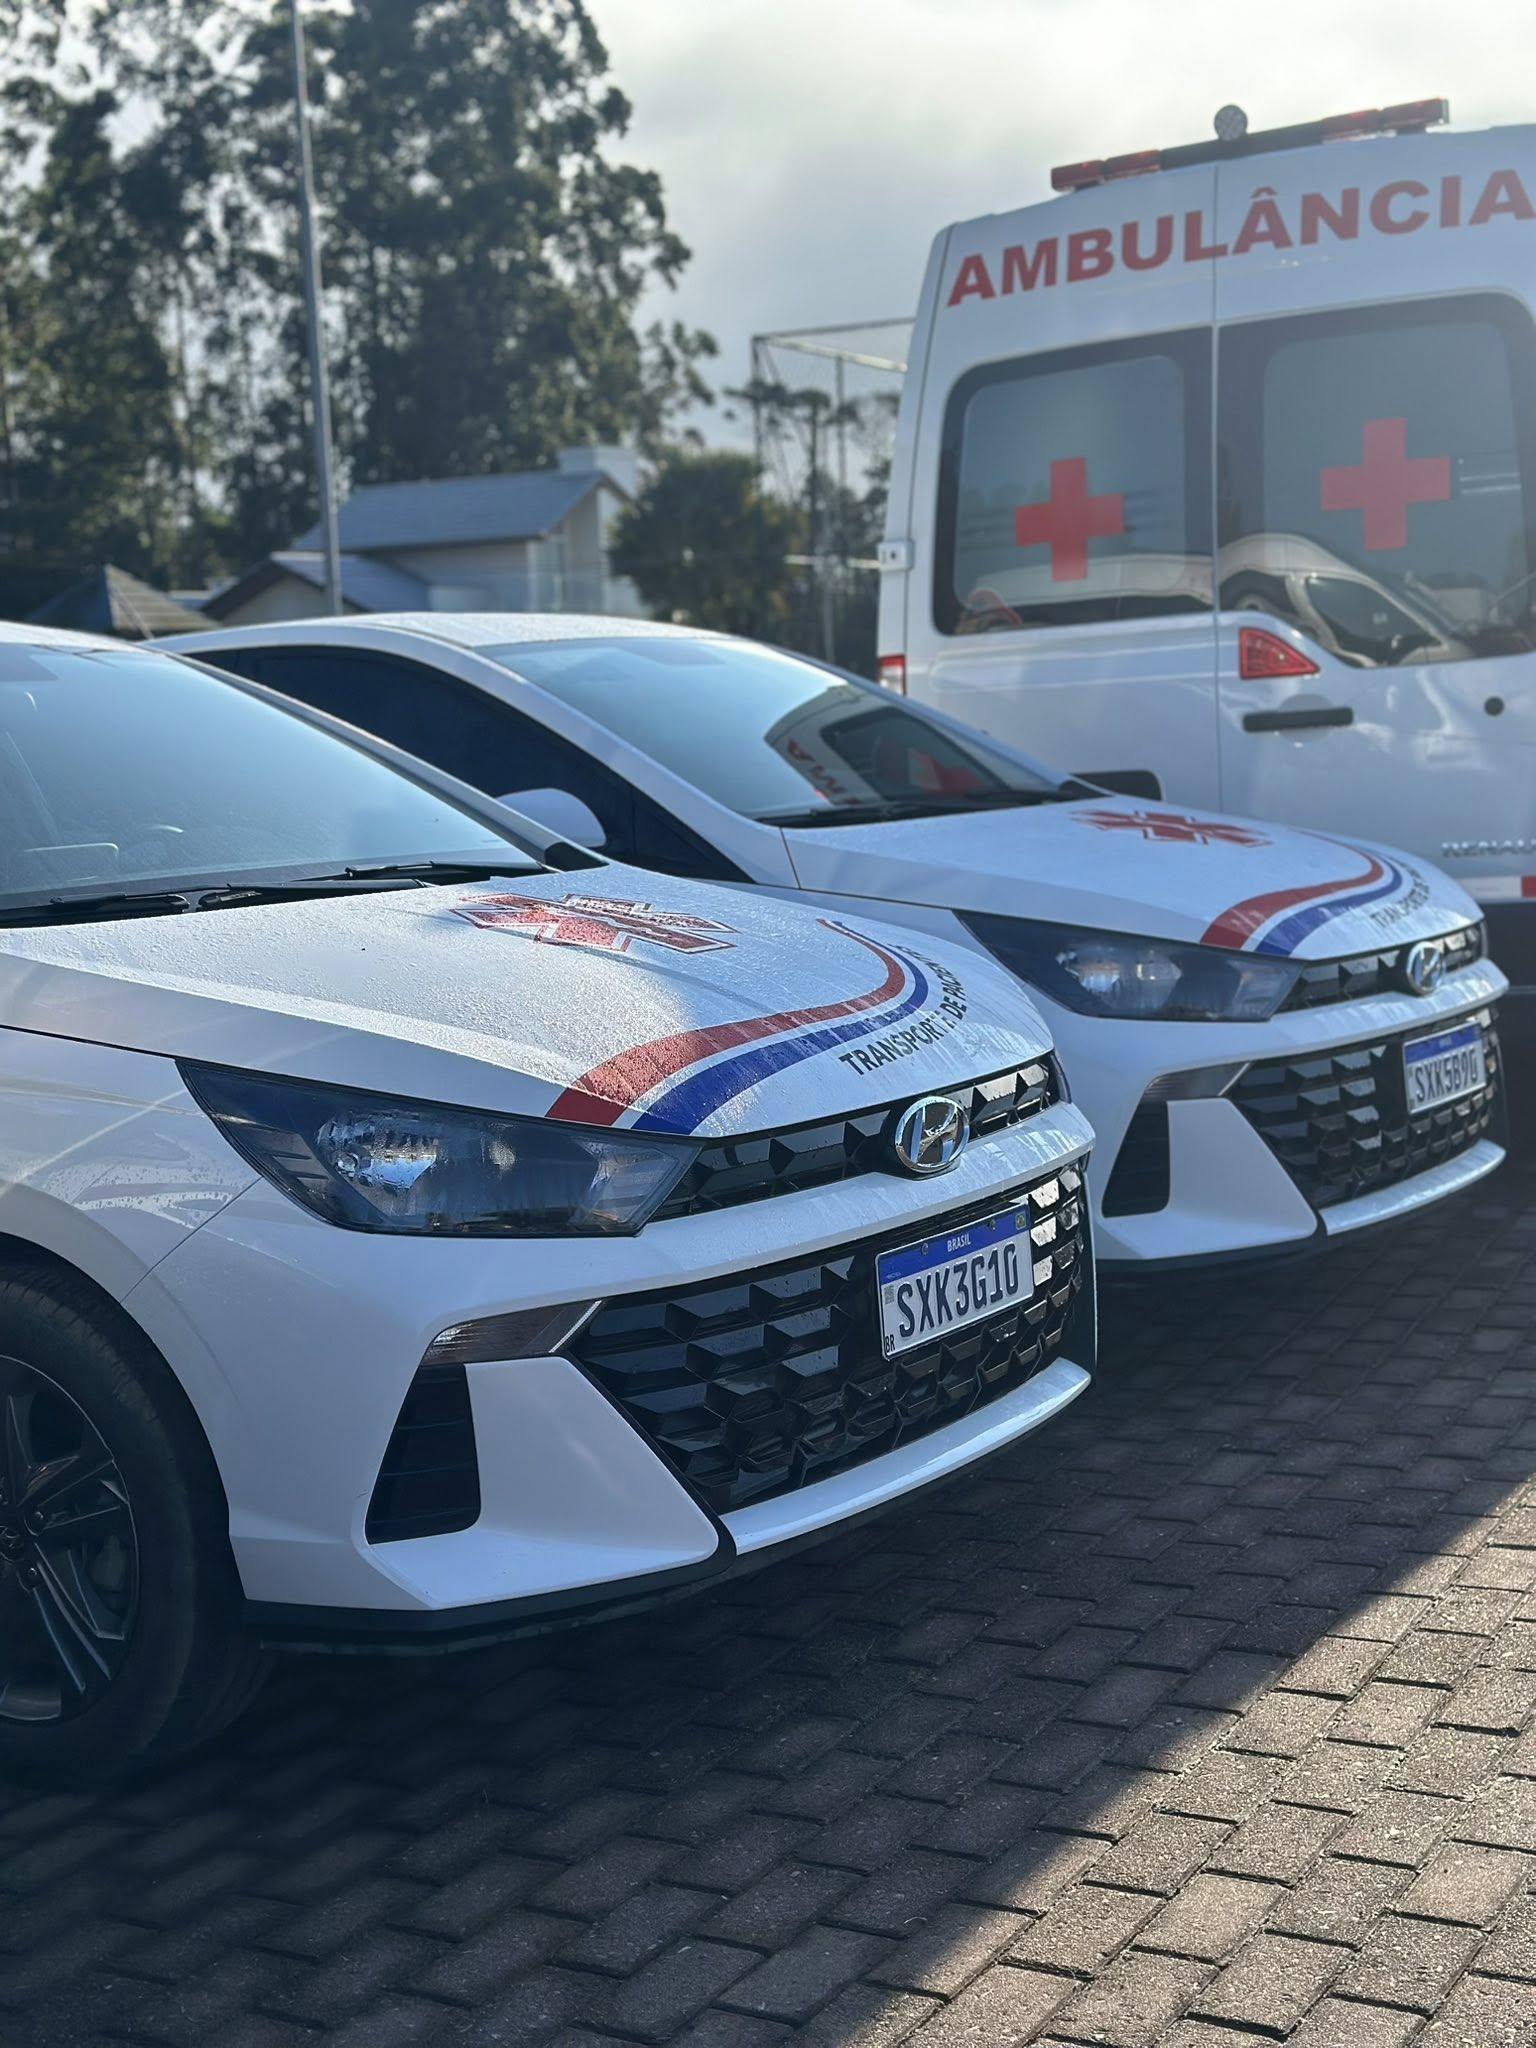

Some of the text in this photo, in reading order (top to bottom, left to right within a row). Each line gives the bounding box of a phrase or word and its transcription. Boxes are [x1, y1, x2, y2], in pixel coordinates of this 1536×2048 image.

[947, 170, 1536, 307] AMBULÂNCIA
[939, 995, 967, 1020] DE
[947, 1233, 971, 1252] BRASIL
[897, 1242, 1019, 1338] SXK3G10
[884, 1334, 895, 1353] BR
